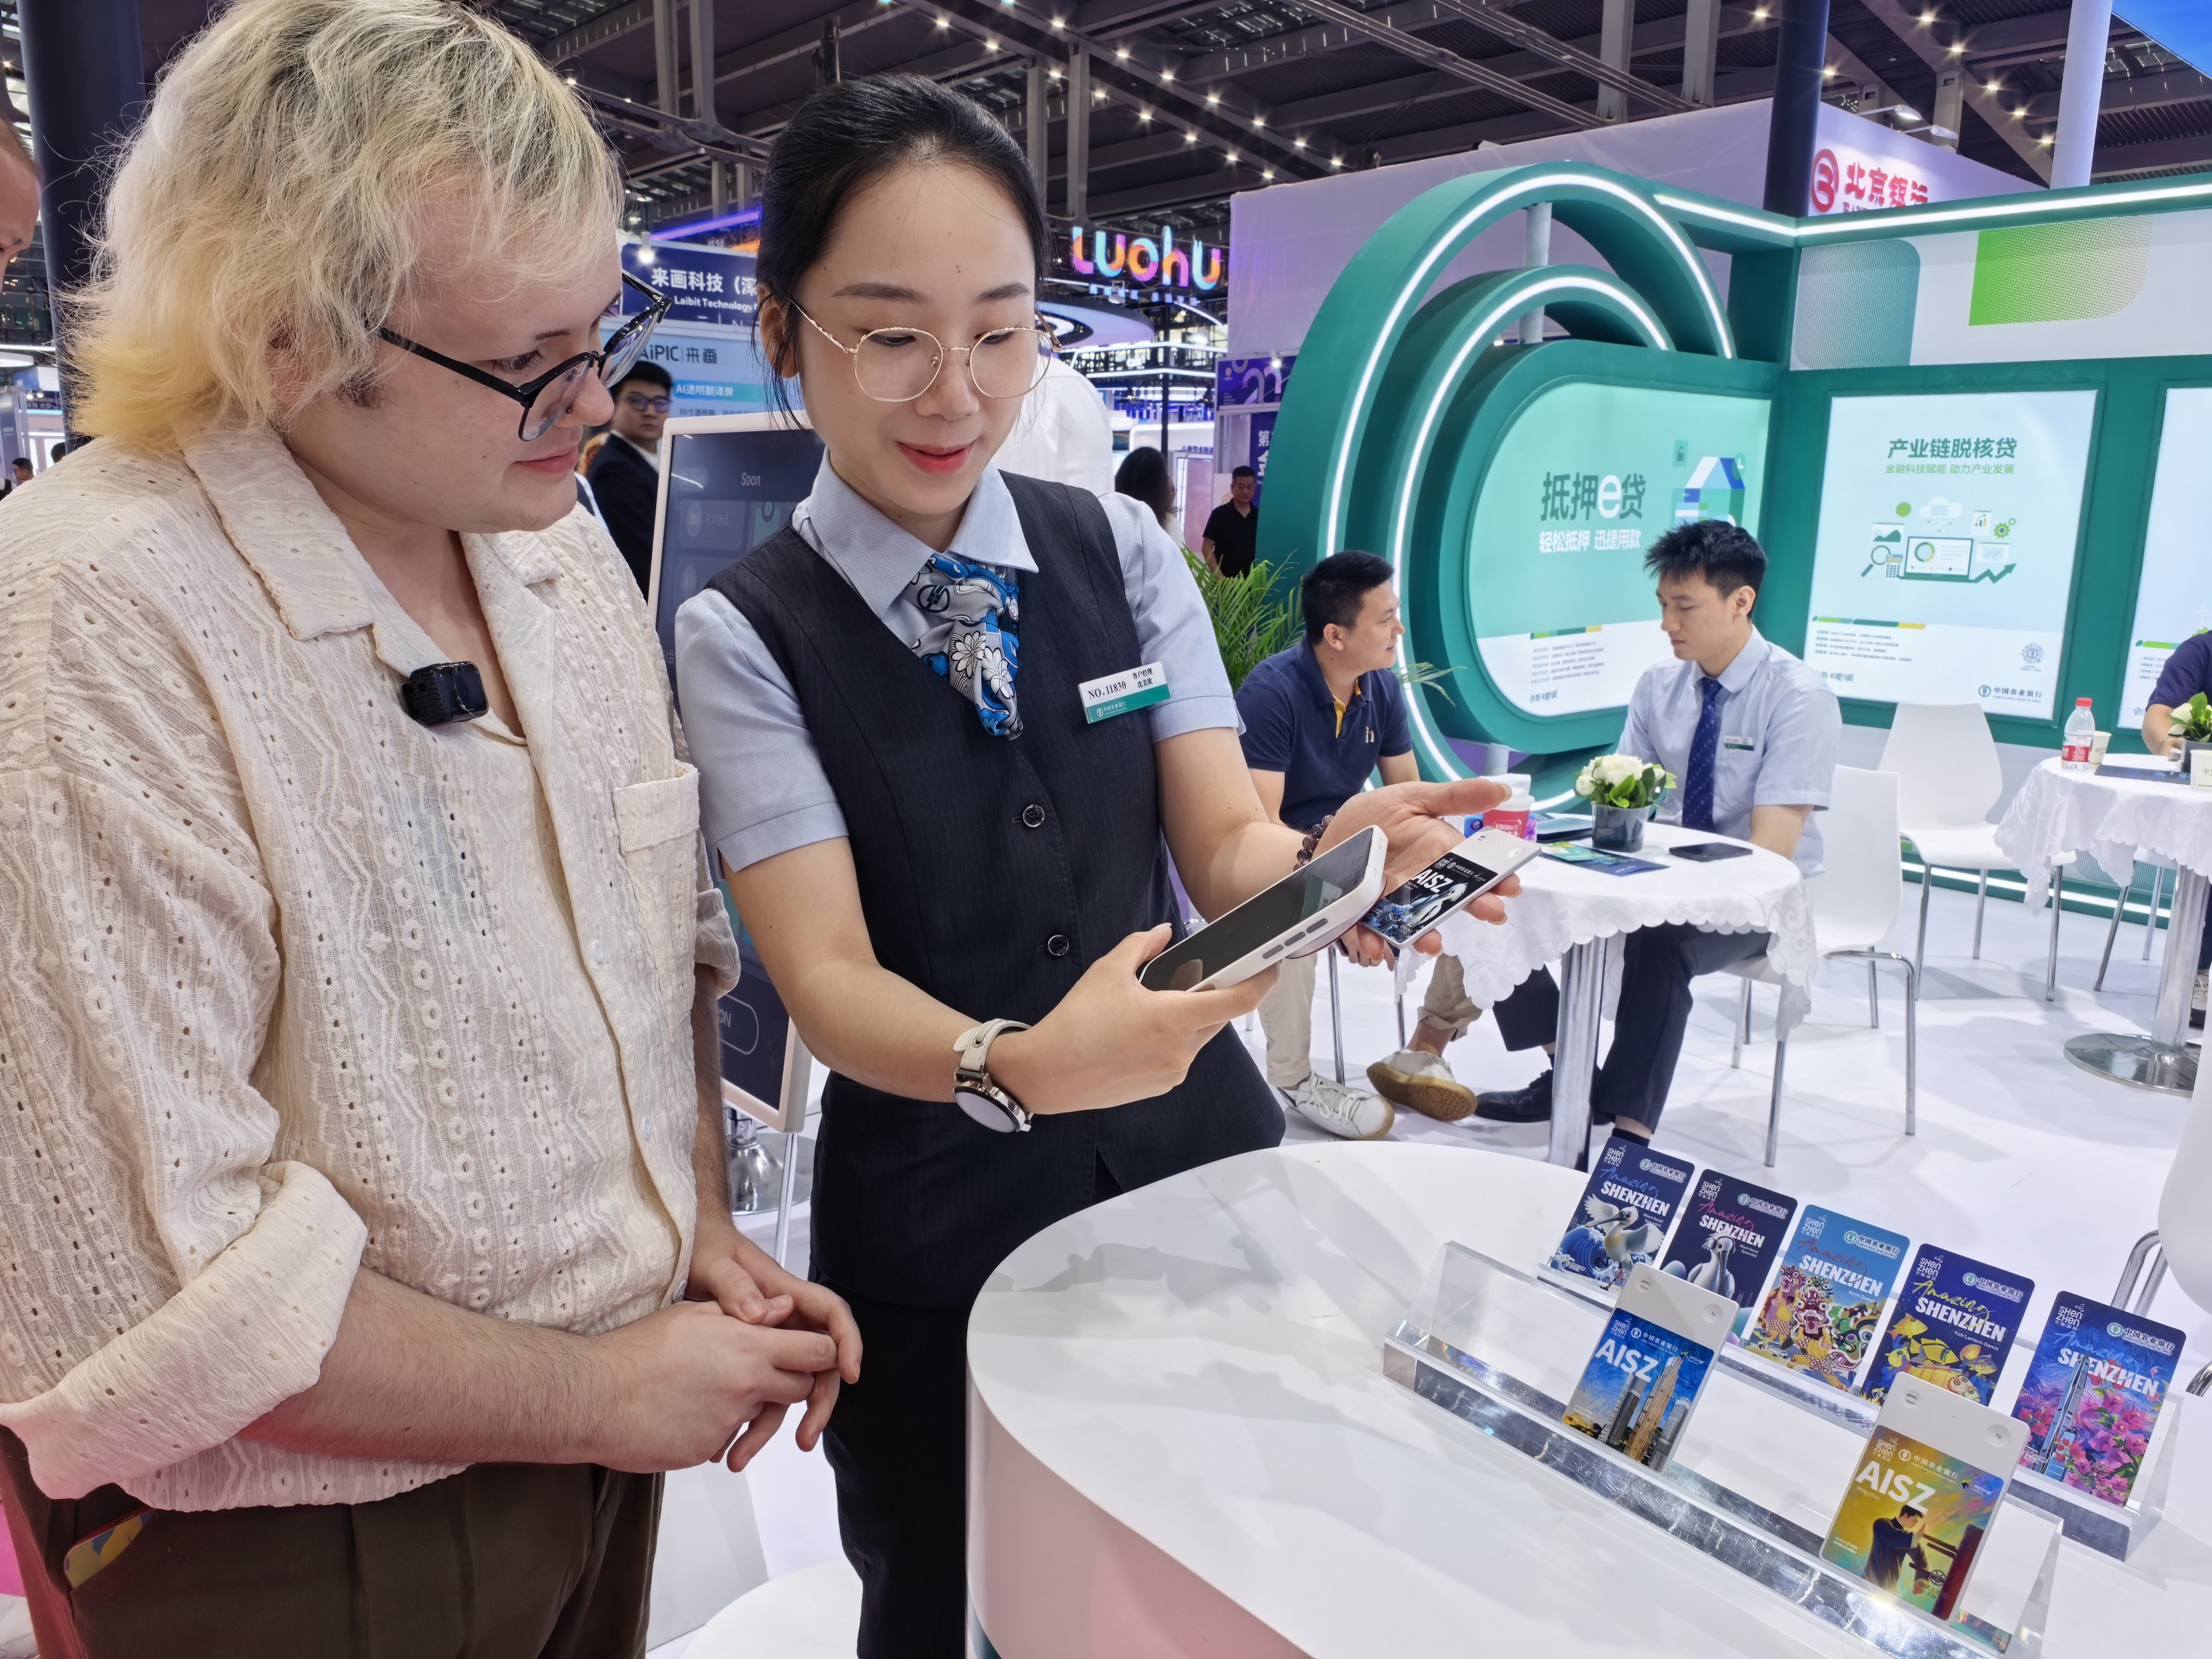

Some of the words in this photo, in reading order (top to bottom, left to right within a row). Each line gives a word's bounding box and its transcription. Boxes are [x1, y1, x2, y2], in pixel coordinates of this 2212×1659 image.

[674, 296, 702, 308] Laibit
[702, 299, 752, 313] Technology
[1887, 437, 2018, 459] 产业链脱核贷
[741, 472, 761, 486] Soon
[1949, 463, 2015, 475] 助力产业发展
[1540, 471, 1646, 522] 抵押e贷
[1539, 530, 1591, 554] 轻松抵押
[1594, 528, 1642, 551] 迅捷用款
[1088, 681, 1127, 700] NO.11830
[1993, 687, 2043, 698] 中国农业银行
[1411, 868, 1454, 893] AISZ
[1601, 1181, 1670, 1217] SHENZHEN
[1699, 1215, 1765, 1248] SHENZHEN
[1858, 1235, 1900, 1254] 中国农业银行
[1799, 1255, 1884, 1297] SHENZHEN
[1978, 1278, 2024, 1298] 中国农业银行
[1912, 1280, 1993, 1324] Amazing
[1915, 1296, 2007, 1343] SHENZHEN
[1642, 1332, 1678, 1352] 中国农业银行
[1984, 1341, 1999, 1351] Dance
[2124, 1328, 2175, 1350] 中国农业银行
[1595, 1338, 1660, 1383] AISZ
[1854, 1460, 1937, 1514] AISZ
